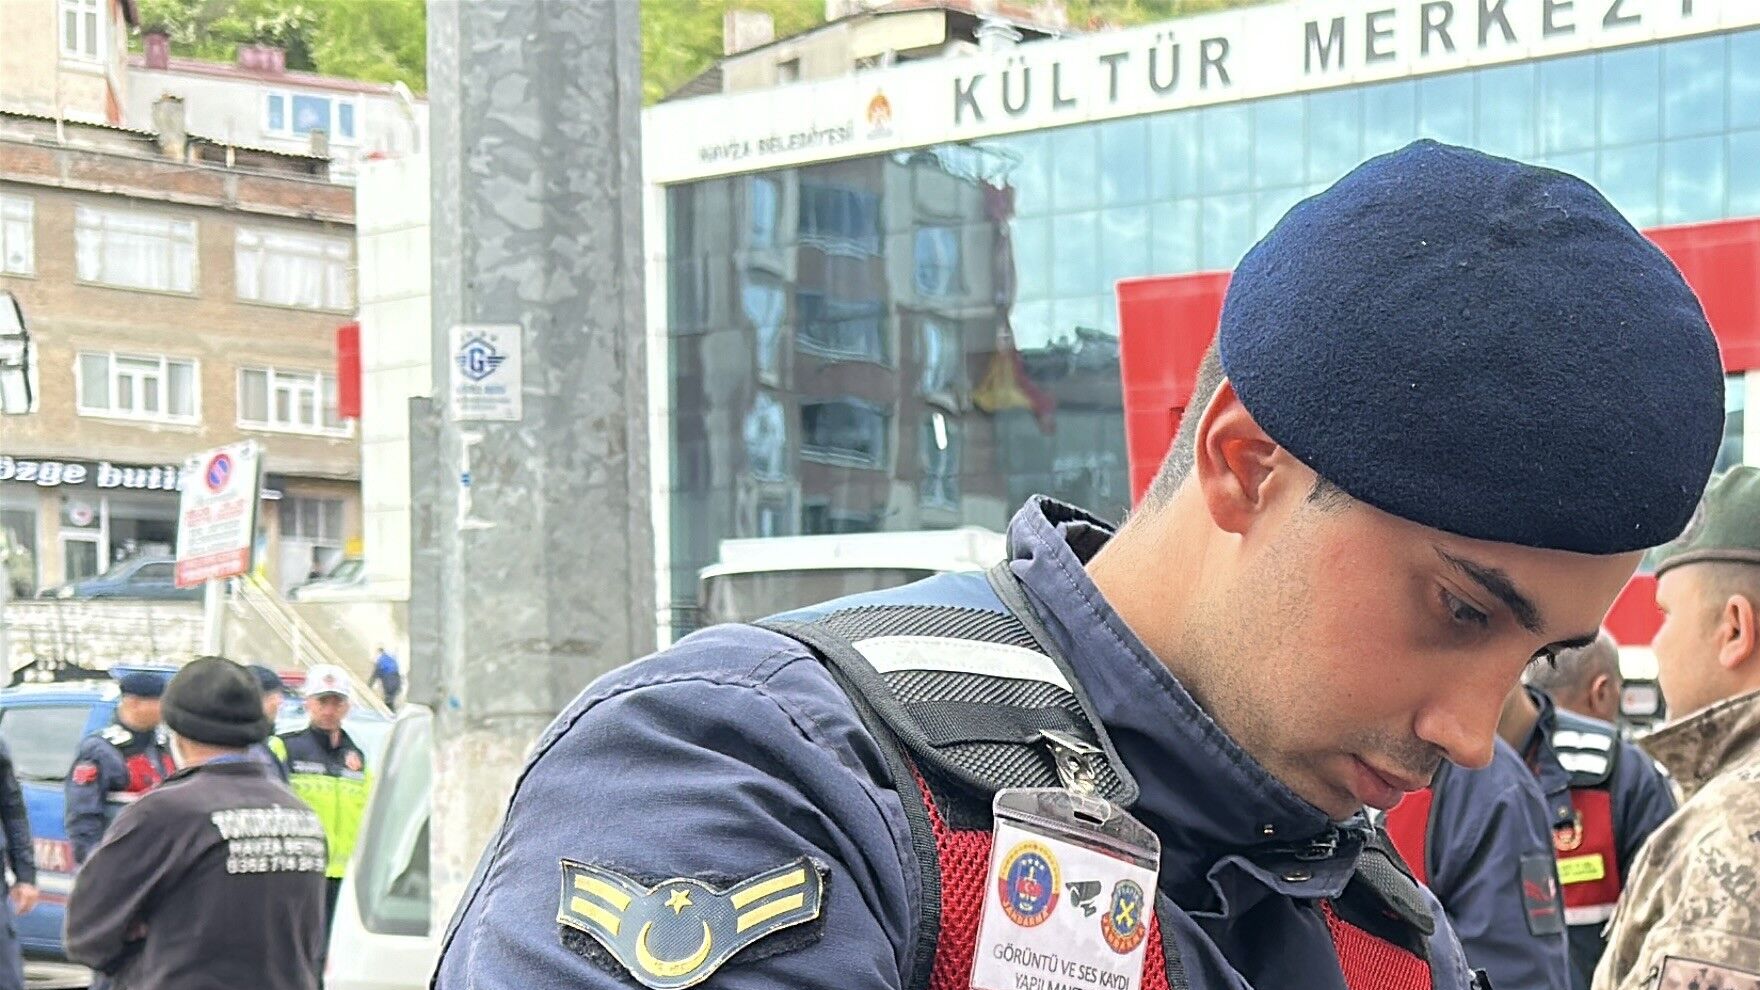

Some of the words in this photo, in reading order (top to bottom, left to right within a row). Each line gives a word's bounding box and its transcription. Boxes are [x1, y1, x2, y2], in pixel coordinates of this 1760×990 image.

[954, 30, 1231, 125] KÜLTÜR
[992, 943, 1059, 973] GÖRÜNTÜ
[1060, 959, 1077, 978] VE
[1077, 965, 1098, 984] SES
